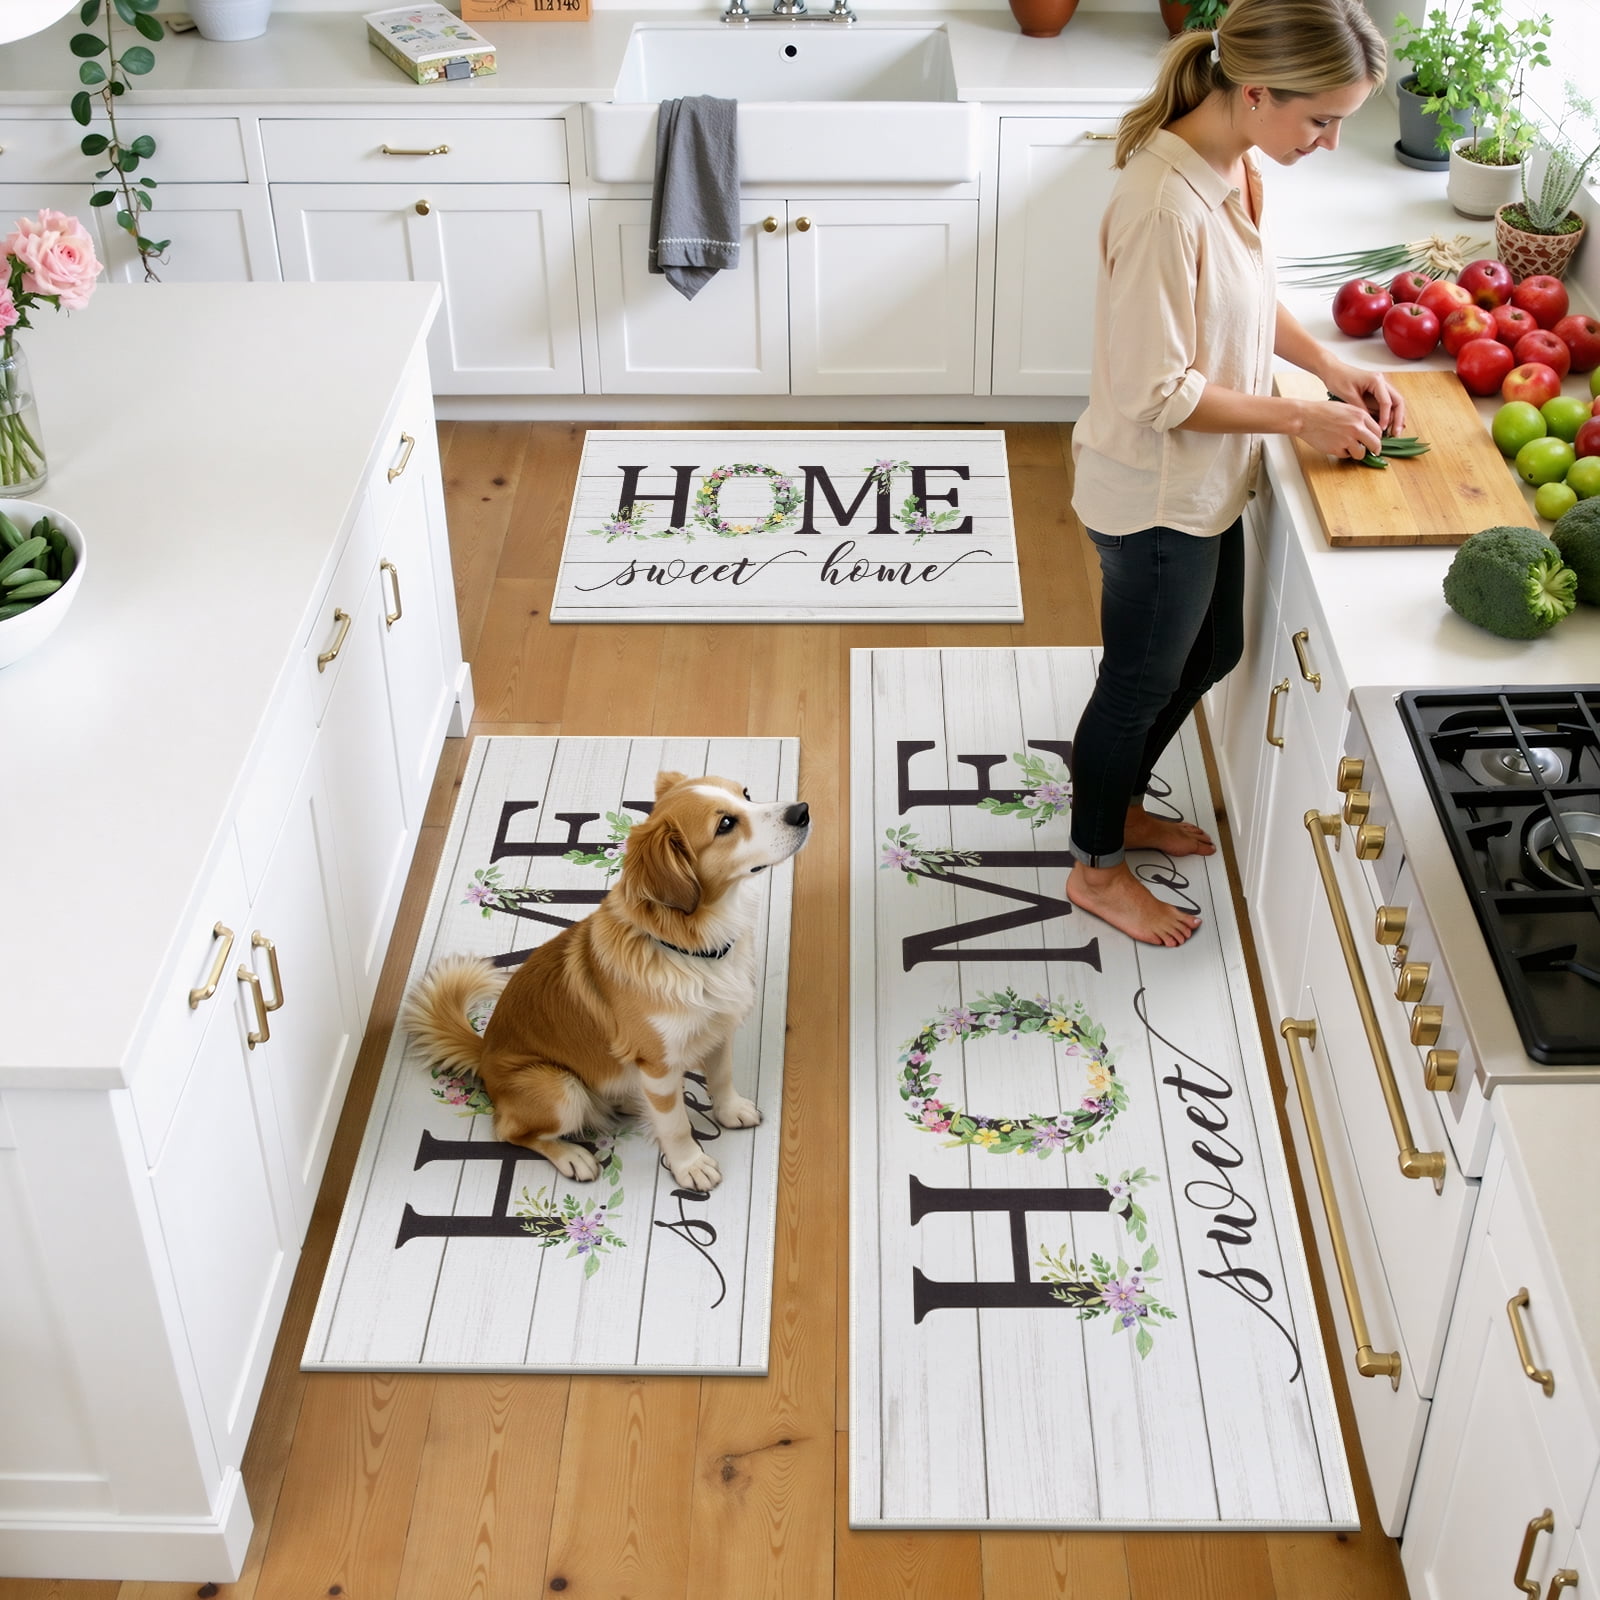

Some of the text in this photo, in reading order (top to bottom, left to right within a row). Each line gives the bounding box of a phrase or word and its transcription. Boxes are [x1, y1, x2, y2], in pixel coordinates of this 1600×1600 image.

[574, 540, 992, 592] sweet home
[612, 462, 973, 536] HOME
[897, 739, 1149, 1325] HOME
[1134, 987, 1302, 1383] sweet
